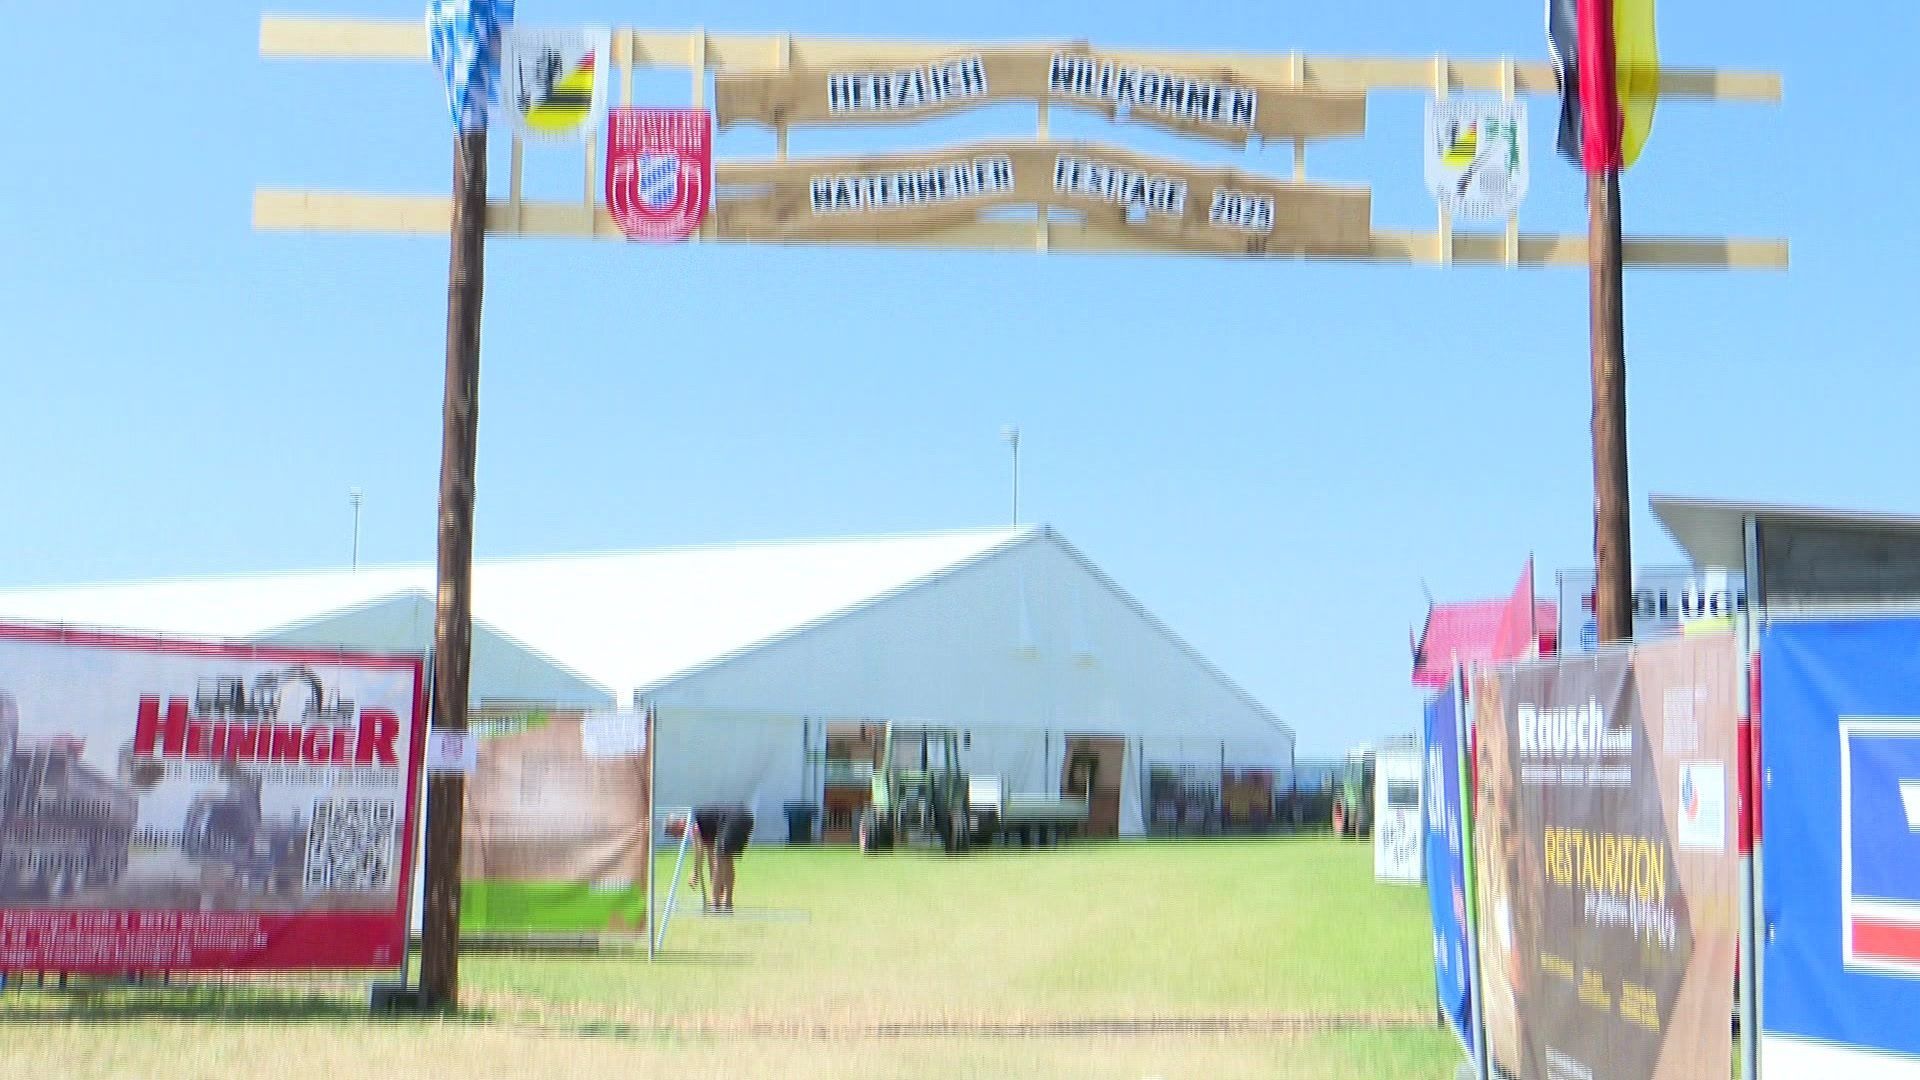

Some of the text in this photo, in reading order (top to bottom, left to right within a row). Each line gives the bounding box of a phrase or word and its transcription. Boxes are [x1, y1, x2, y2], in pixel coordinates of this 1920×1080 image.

[829, 54, 1255, 127] HERZLICH WILLKOMMEN
[812, 157, 1273, 230] WATTENWEILER FESTTAGE 2025
[133, 693, 399, 766] HEININGER
[1518, 696, 1603, 757] Rausch
[1545, 827, 1665, 902] RESTAURATION
